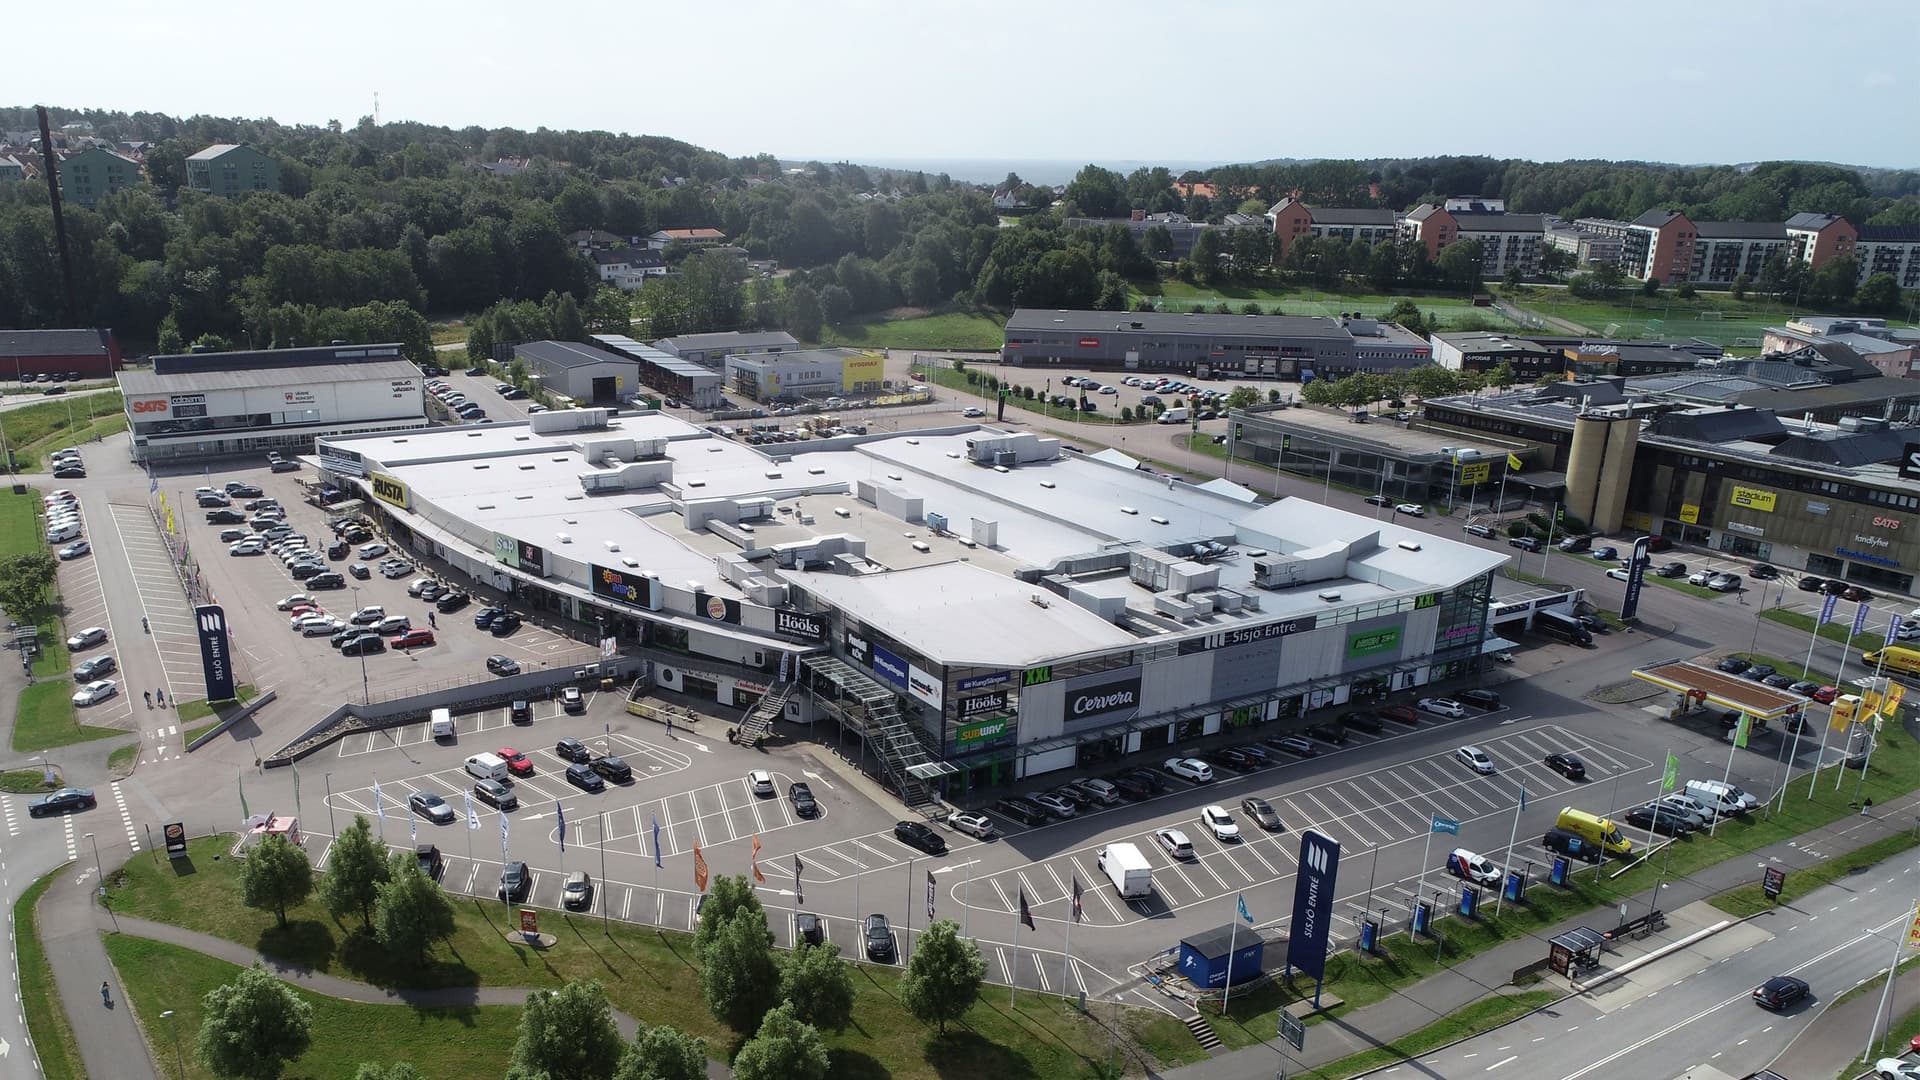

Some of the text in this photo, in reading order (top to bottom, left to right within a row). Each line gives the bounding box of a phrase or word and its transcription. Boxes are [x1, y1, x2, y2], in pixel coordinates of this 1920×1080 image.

[133, 400, 167, 413] SATS
[373, 478, 404, 502] RUSTA
[1737, 490, 1771, 503] stadium
[1872, 517, 1900, 529] SATS
[1417, 593, 1436, 608] XXL
[779, 613, 820, 633] Hööks
[1026, 666, 1050, 685] XXL
[965, 695, 1002, 711] Hööks
[1074, 691, 1134, 714] Cervera
[961, 723, 1004, 740] SUBWAY
[1304, 875, 1319, 938] SISJÖ ENTRÉ
